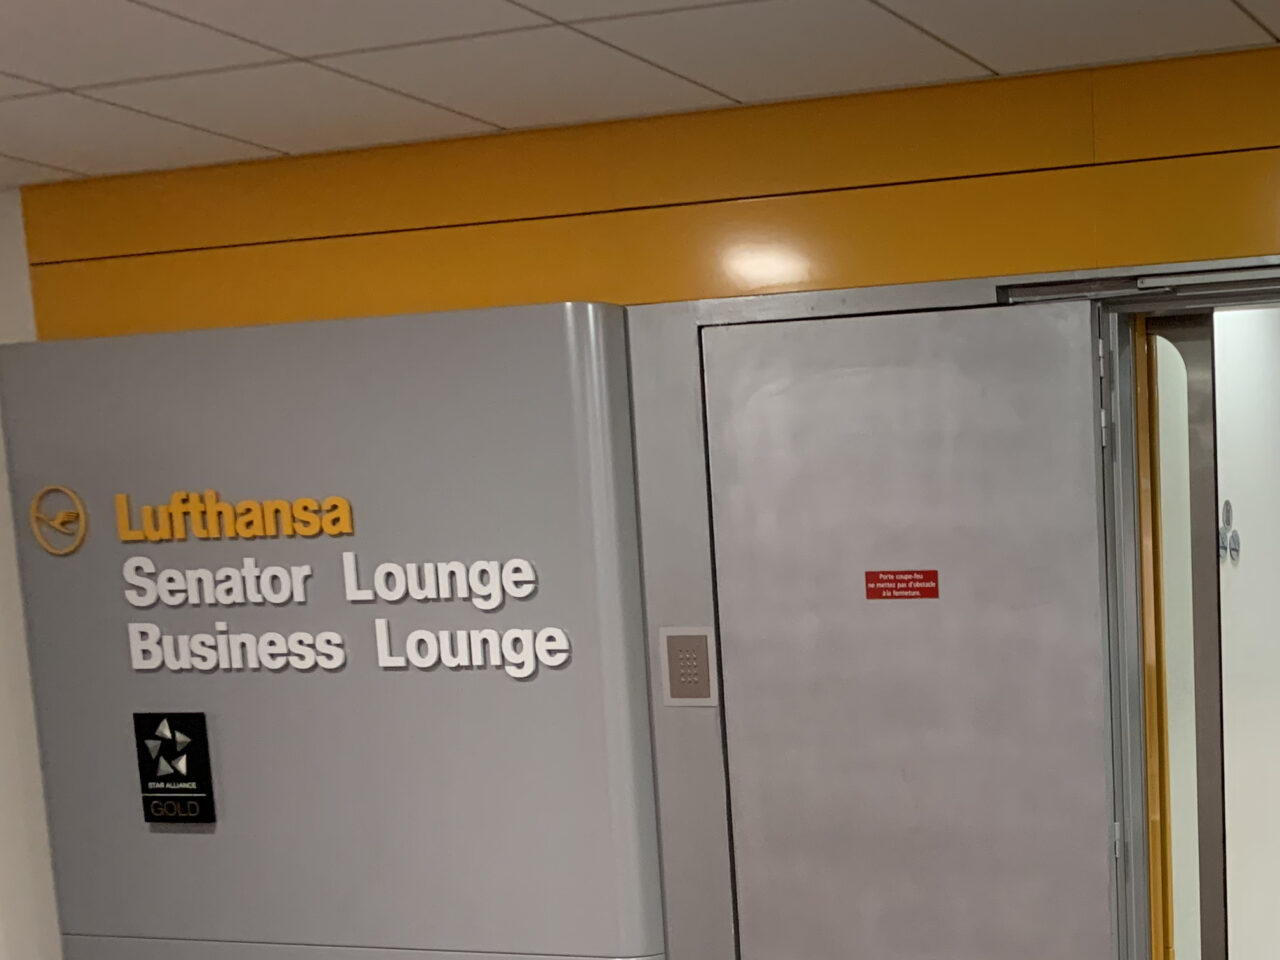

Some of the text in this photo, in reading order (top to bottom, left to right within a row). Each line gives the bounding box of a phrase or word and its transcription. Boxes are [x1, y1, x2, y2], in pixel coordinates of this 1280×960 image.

[115, 490, 354, 541] Lufthansa
[122, 551, 537, 611] Senator Lounge
[127, 618, 571, 678] Business Lounge
[150, 801, 200, 816] GOLD
